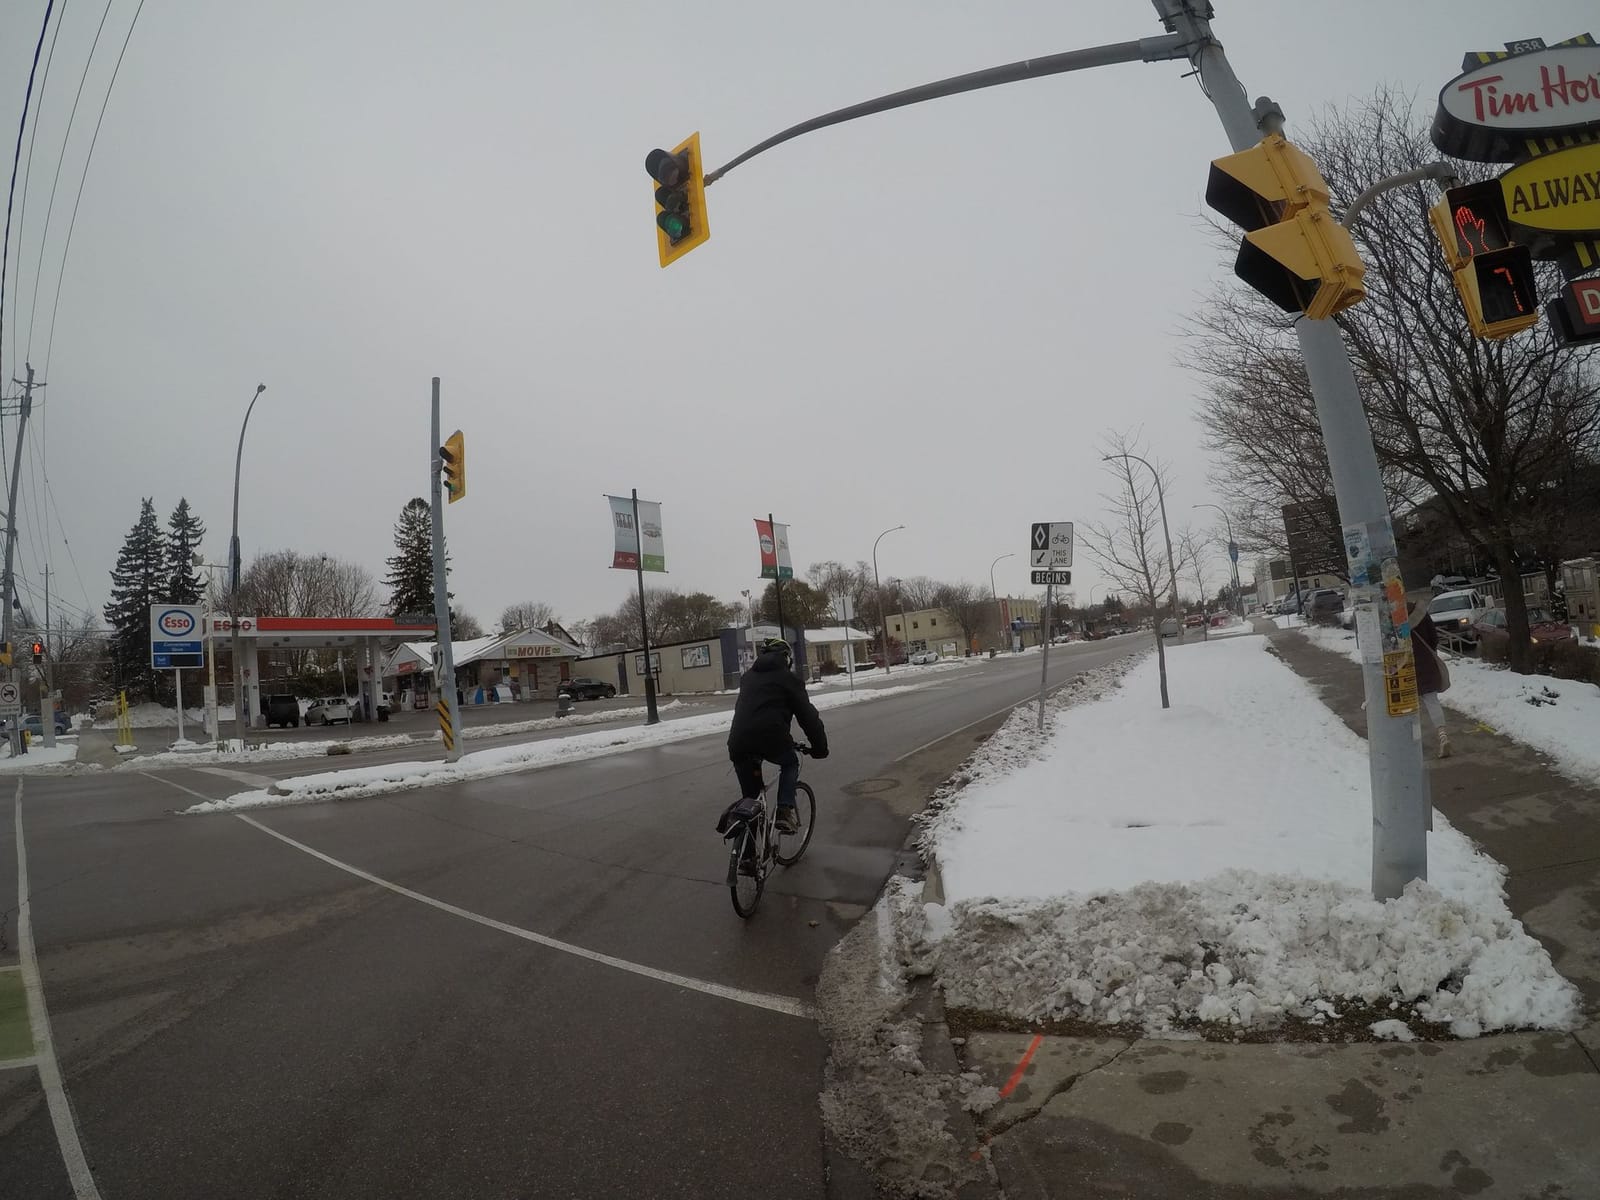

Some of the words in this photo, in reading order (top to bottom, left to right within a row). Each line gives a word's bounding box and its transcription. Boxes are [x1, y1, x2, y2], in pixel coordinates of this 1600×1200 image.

[1458, 75, 1539, 122] Tim
[1540, 64, 1600, 107] Hor
[1052, 549, 1067, 557] THIS
[1035, 572, 1067, 584] BEGINS
[213, 620, 252, 631] ESO
[517, 646, 551, 657] MOVIE
